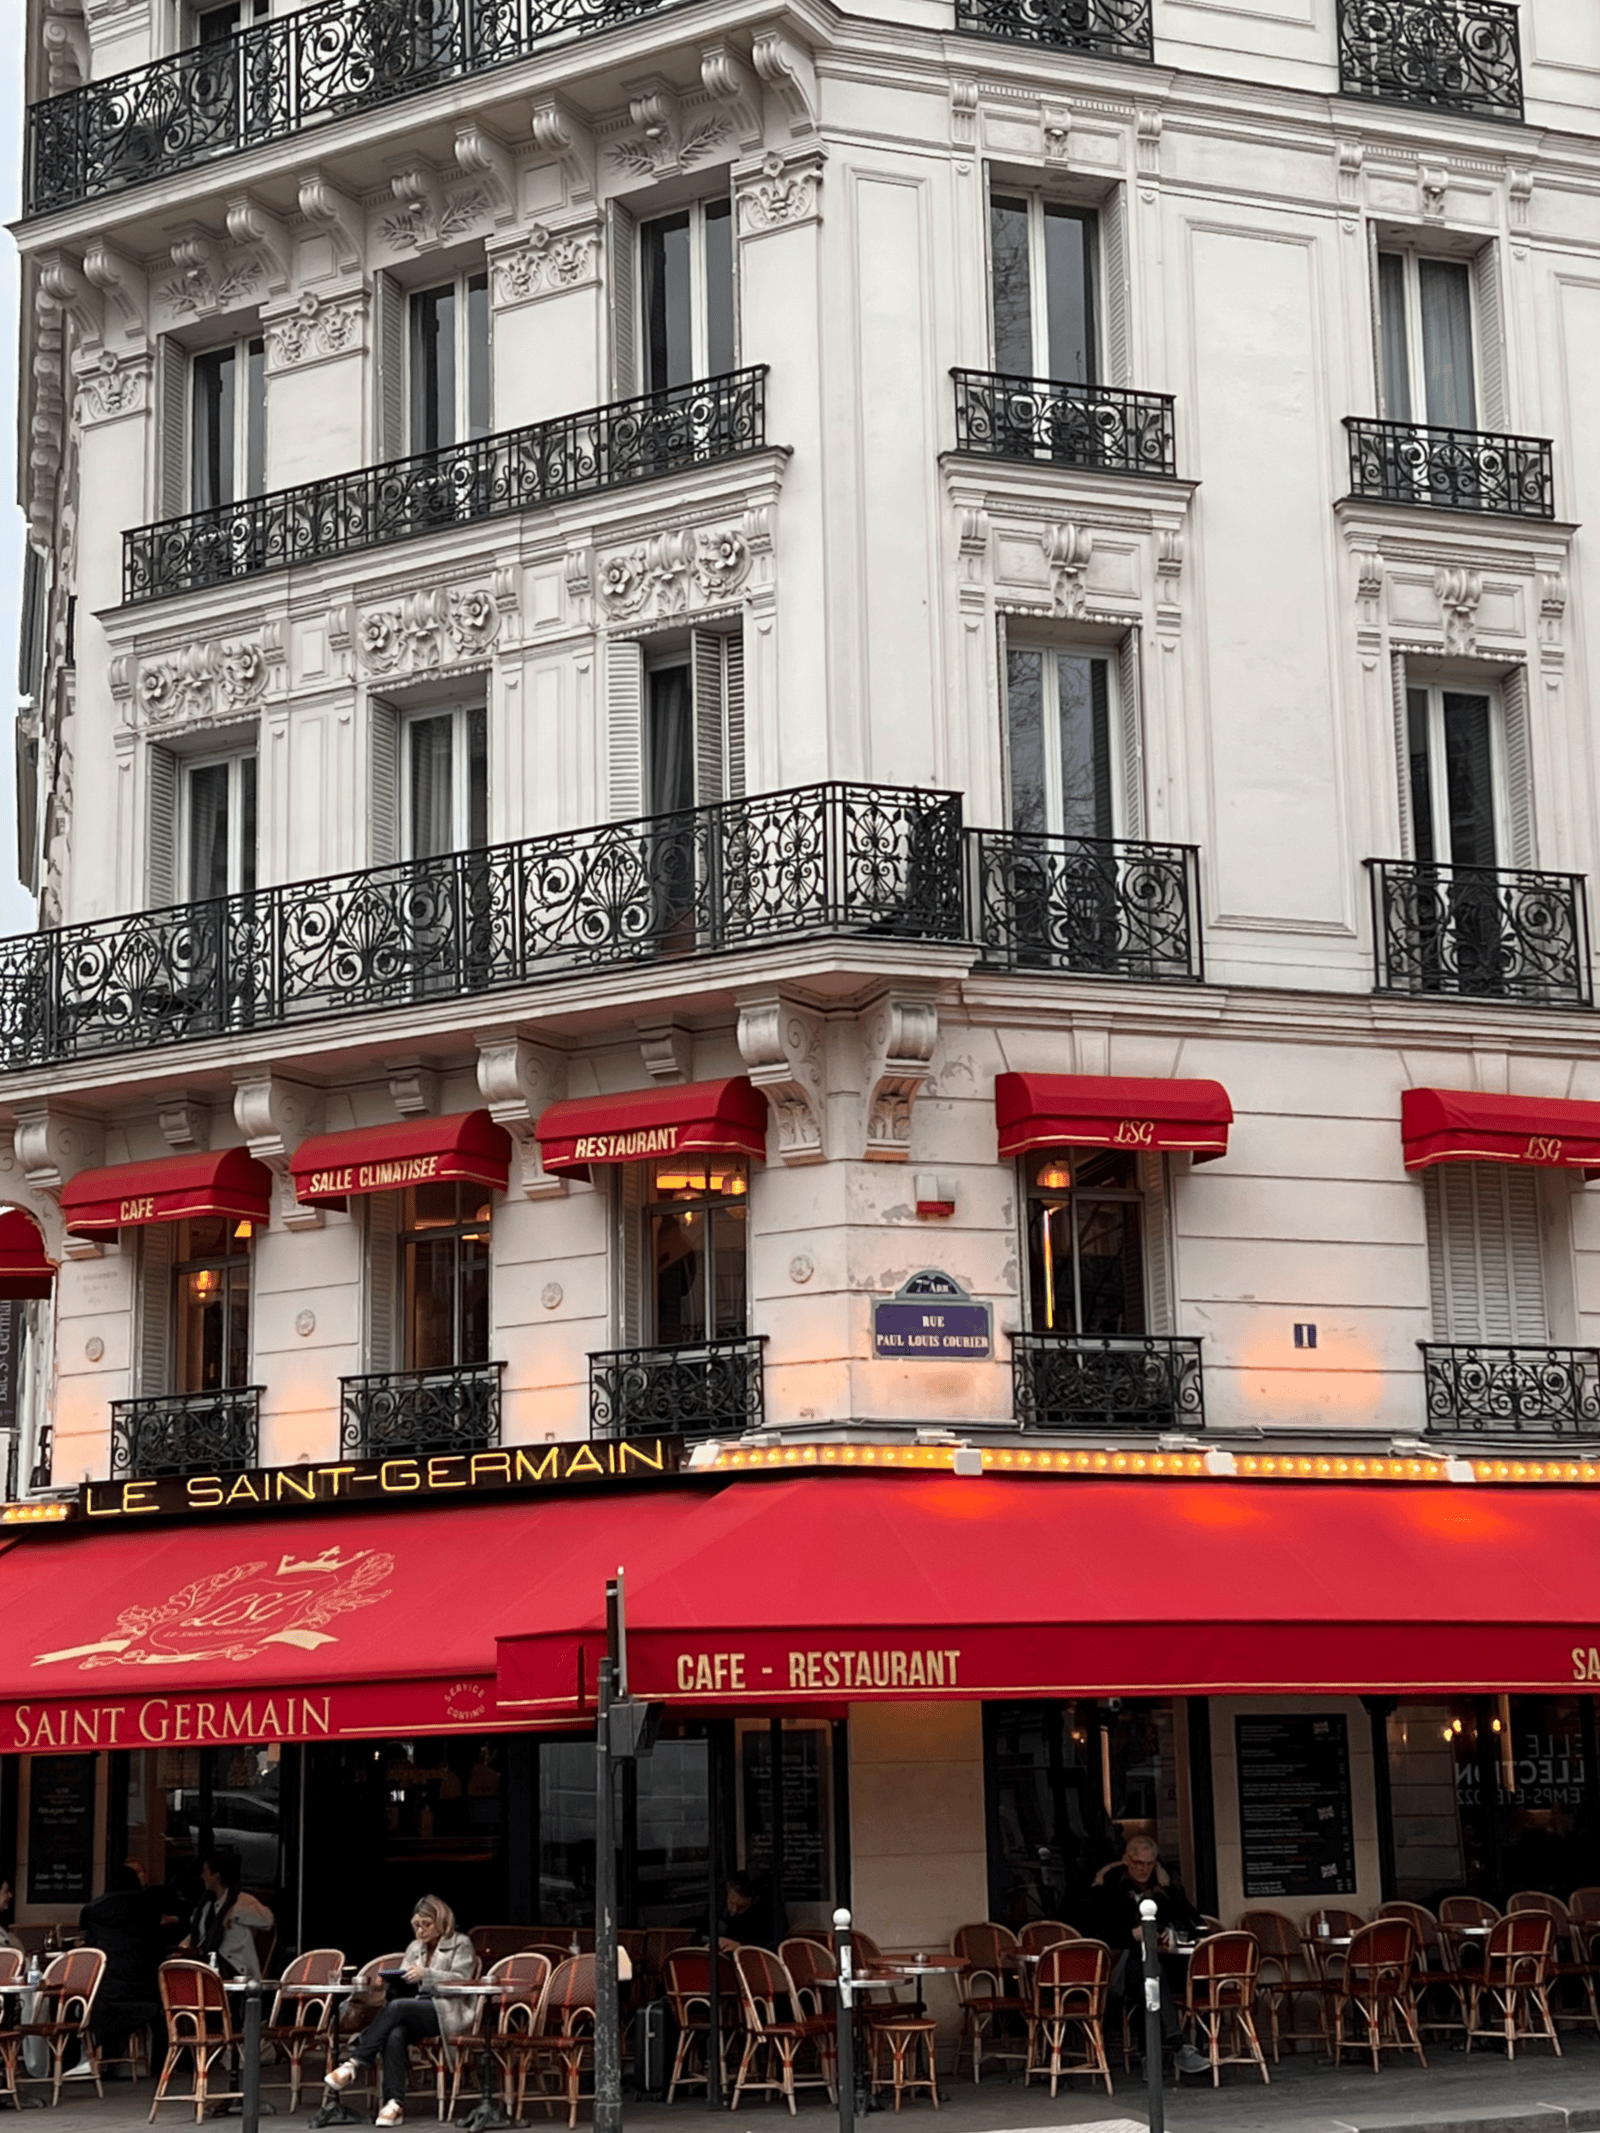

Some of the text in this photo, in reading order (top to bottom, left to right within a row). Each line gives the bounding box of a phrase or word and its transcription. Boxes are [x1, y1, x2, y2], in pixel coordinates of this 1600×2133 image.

[575, 1126, 678, 1158] RESTAURANT
[309, 1155, 439, 1193] SALLE CLIMATISEE
[120, 1197, 154, 1221] CAFE
[922, 1315, 945, 1327] RUE
[876, 1334, 988, 1348] PAUL LOUIS COURIER
[86, 1439, 664, 1516] LE SAINT-GERMAIN
[677, 1654, 746, 1690] CAFE
[788, 1650, 961, 1688] RESTAURANT
[444, 1683, 485, 1702] SERVICE
[14, 1697, 331, 1747] SAINT GERMAIN
[447, 1704, 485, 1720] CONTINU
